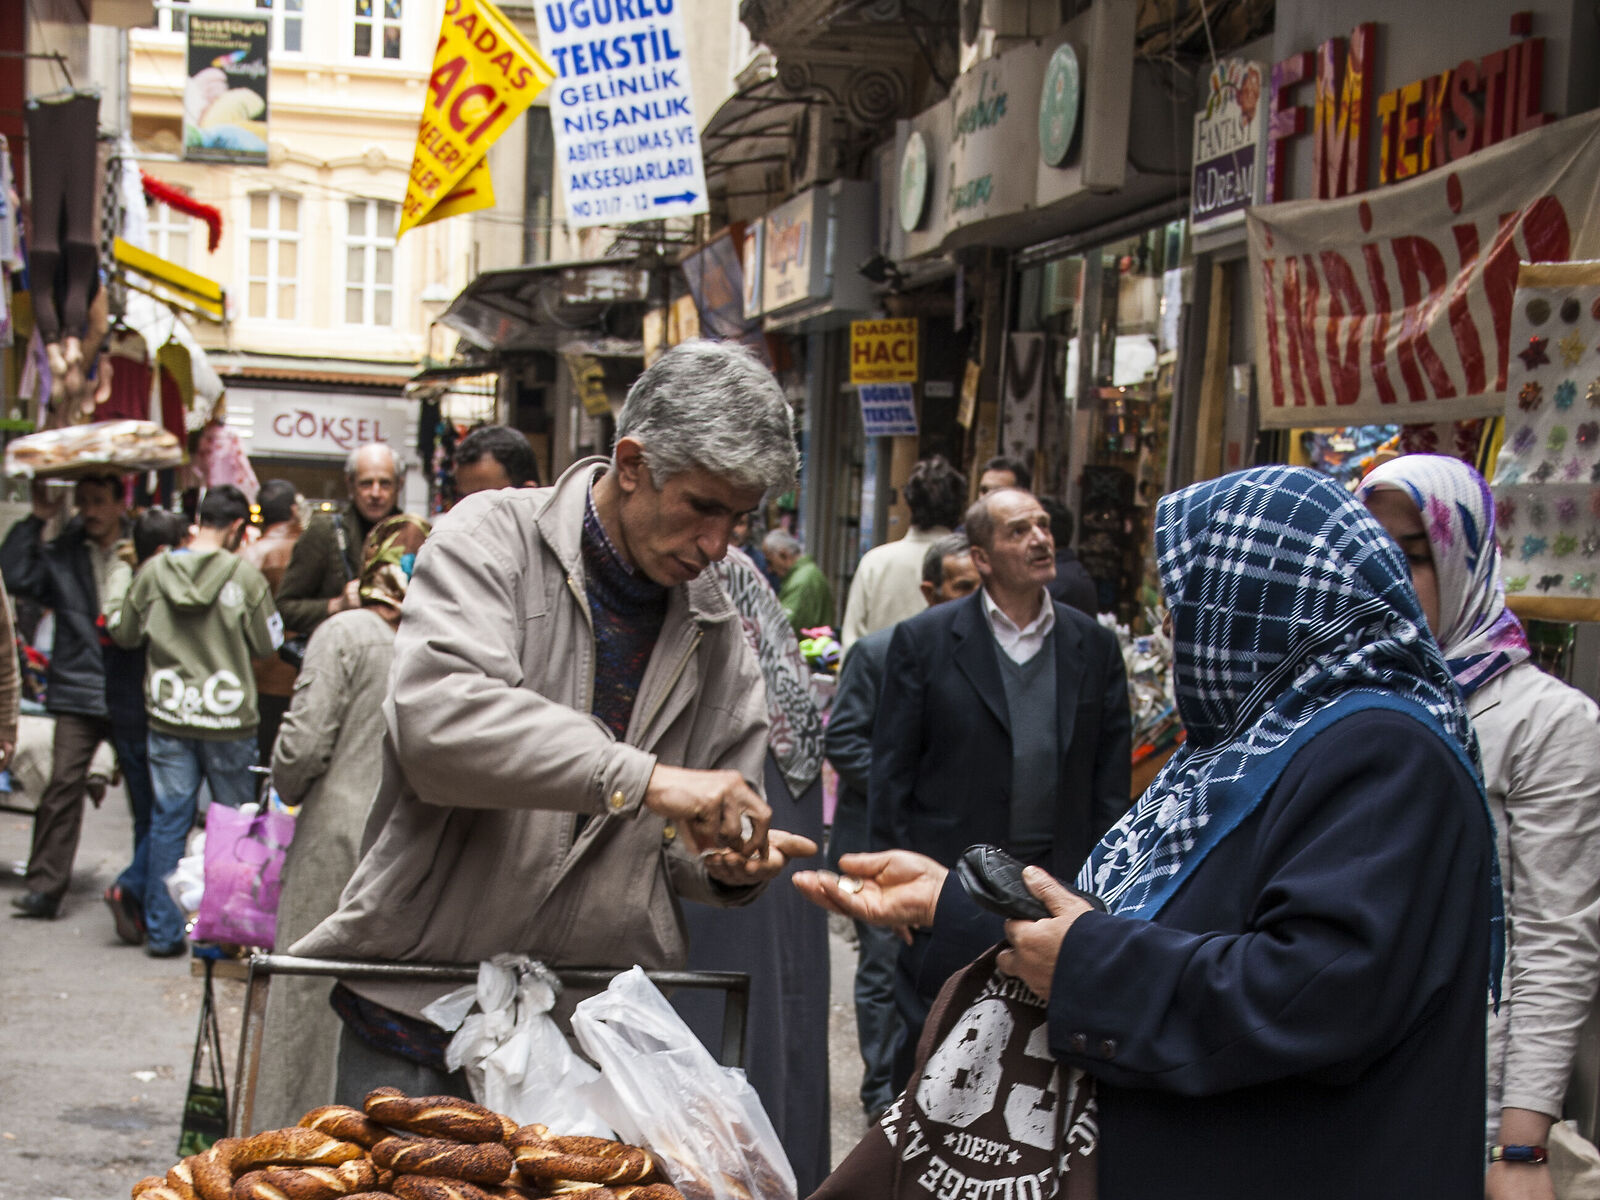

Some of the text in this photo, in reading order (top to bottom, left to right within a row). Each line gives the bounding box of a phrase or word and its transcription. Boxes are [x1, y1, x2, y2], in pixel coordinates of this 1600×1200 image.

[552, 25, 680, 78] TEKSTİL
[430, 36, 508, 145] ACI
[560, 67, 680, 106] GELİNLİK
[564, 96, 690, 135] NİŞANLIK
[1266, 12, 1558, 202] FM TEKSTİL
[675, 126, 694, 145] VE
[571, 157, 694, 191] AKSESUARLARI
[853, 340, 915, 364] HACI
[151, 669, 245, 715] D&G
[953, 1132, 1010, 1166] DEPT
